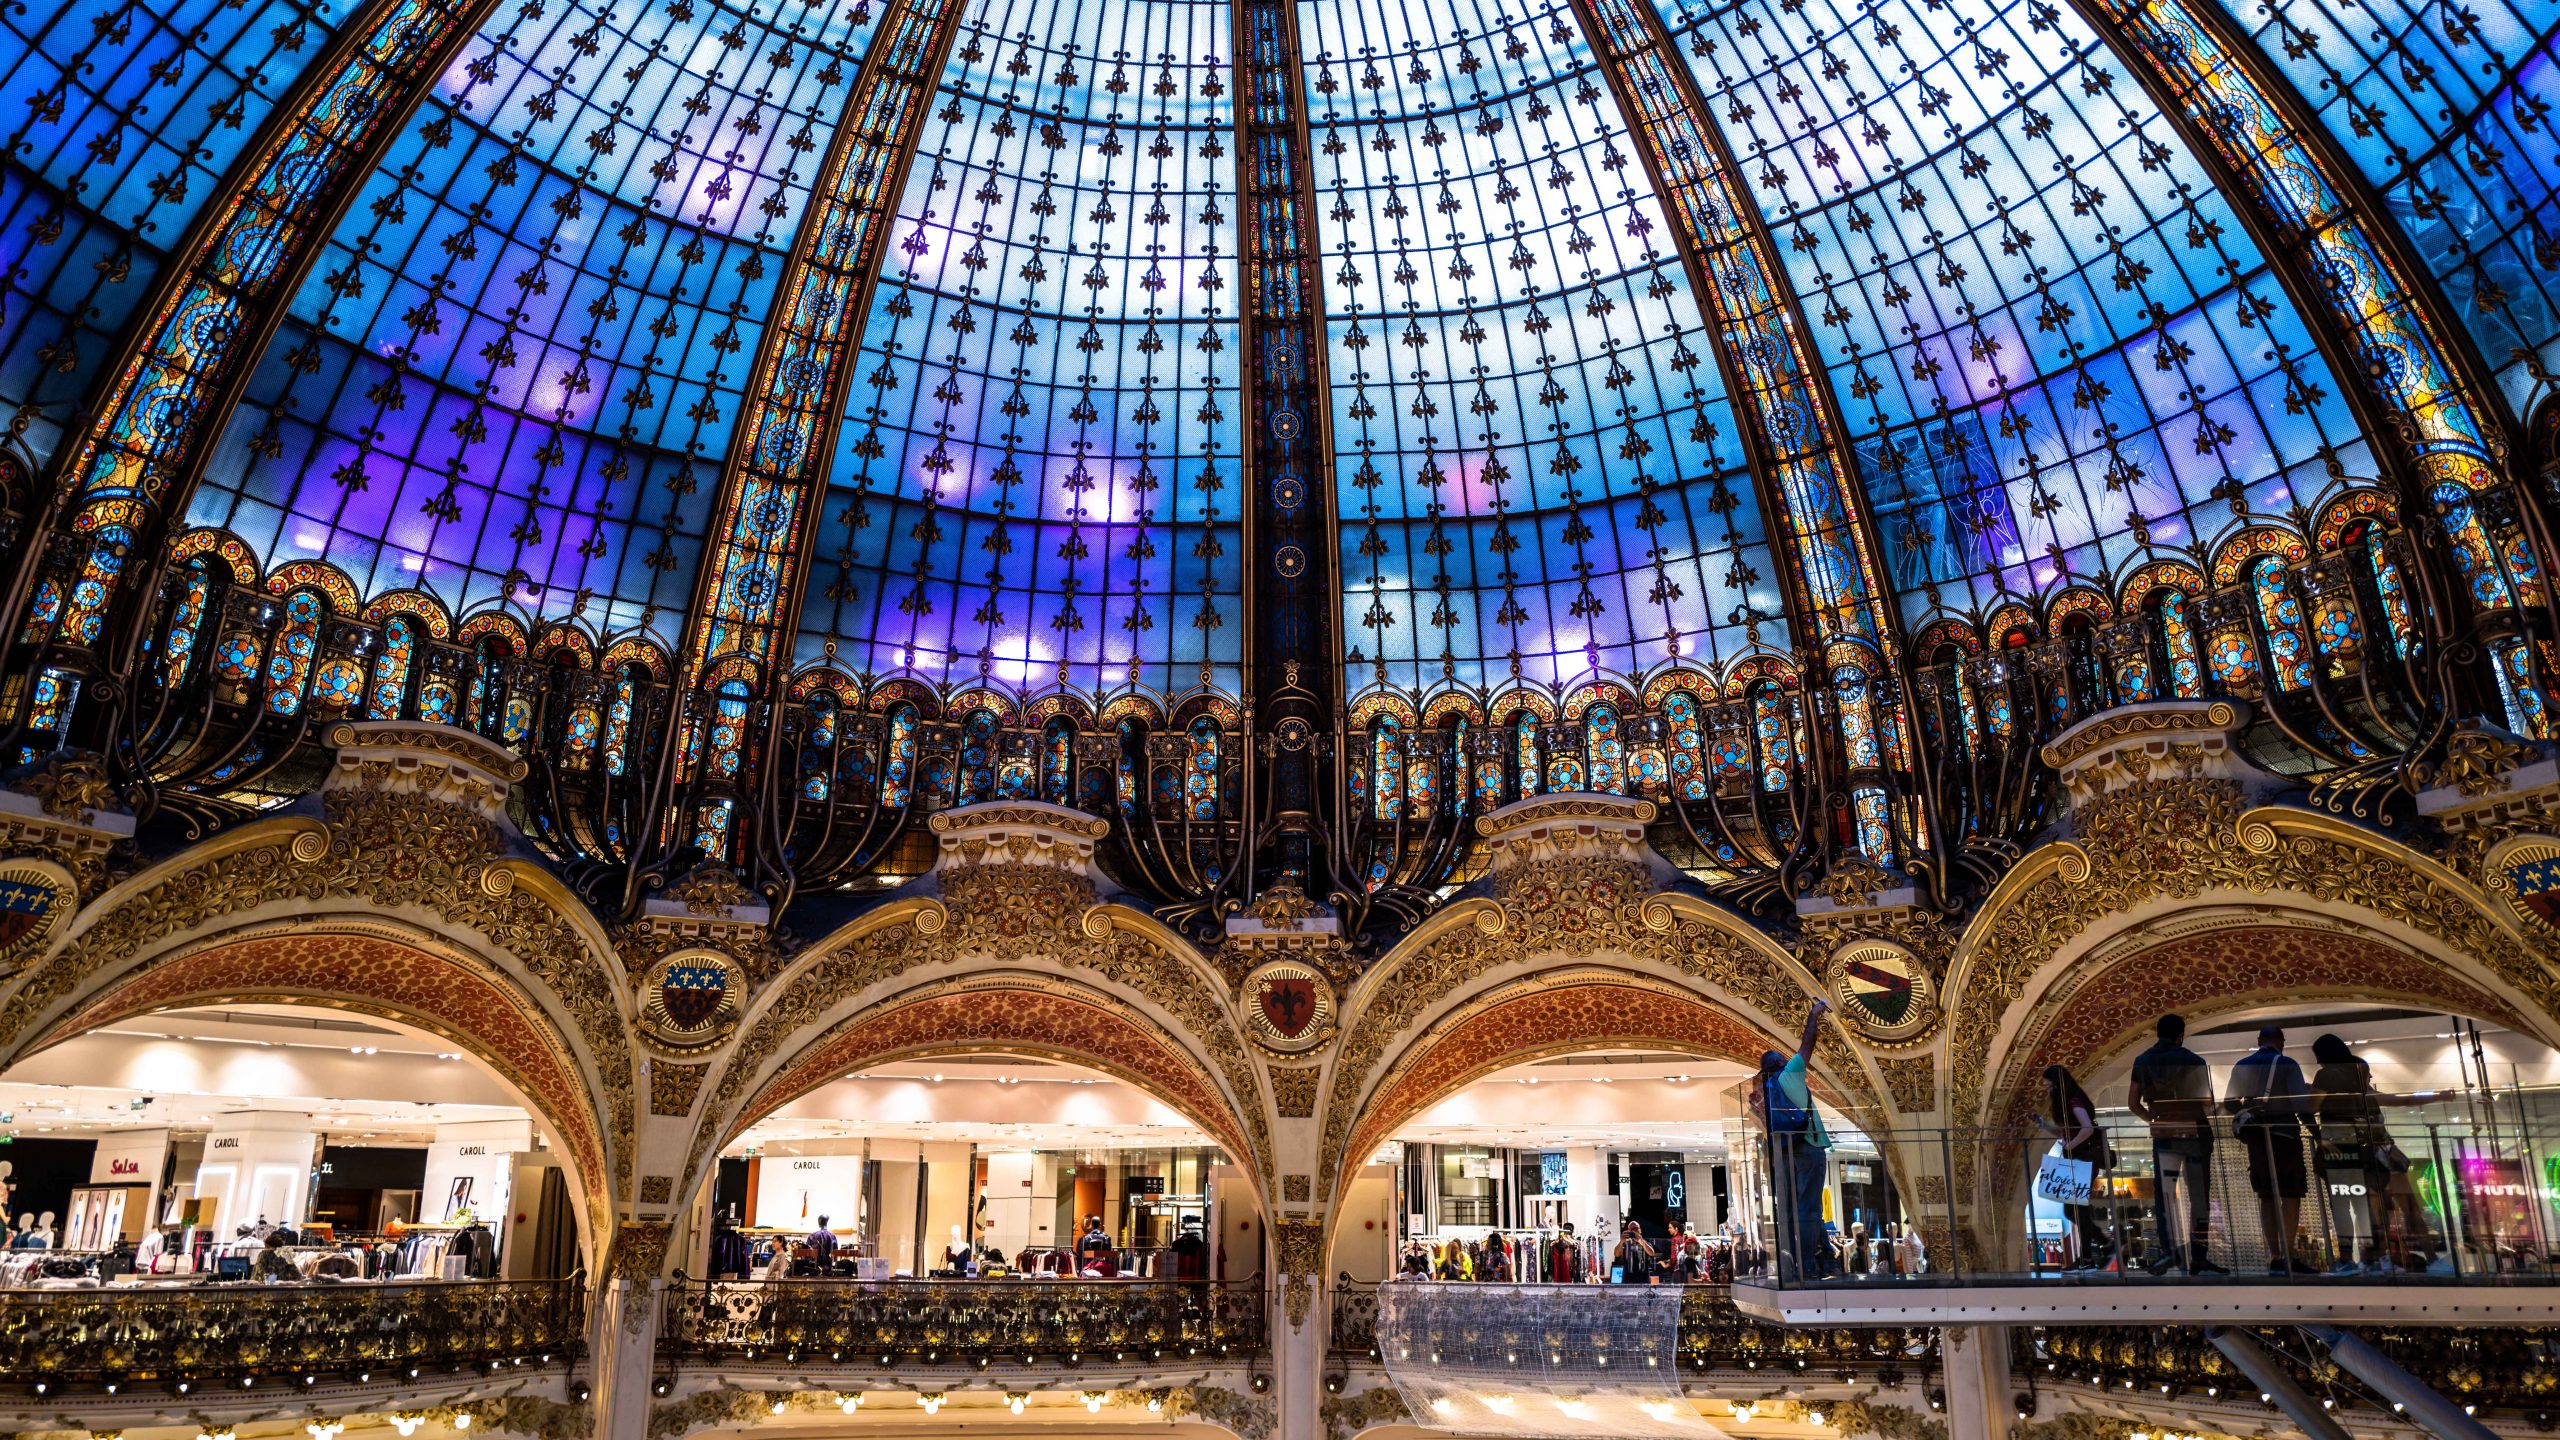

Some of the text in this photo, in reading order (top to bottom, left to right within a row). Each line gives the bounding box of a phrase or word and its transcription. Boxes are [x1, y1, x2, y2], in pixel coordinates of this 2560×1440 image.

[214, 1137, 239, 1149] CAROLL
[459, 1146, 486, 1156] CAROLL
[110, 1158, 140, 1175] Salsa
[793, 1161, 821, 1170] CAROLL
[2330, 1184, 2367, 1196] FRO
